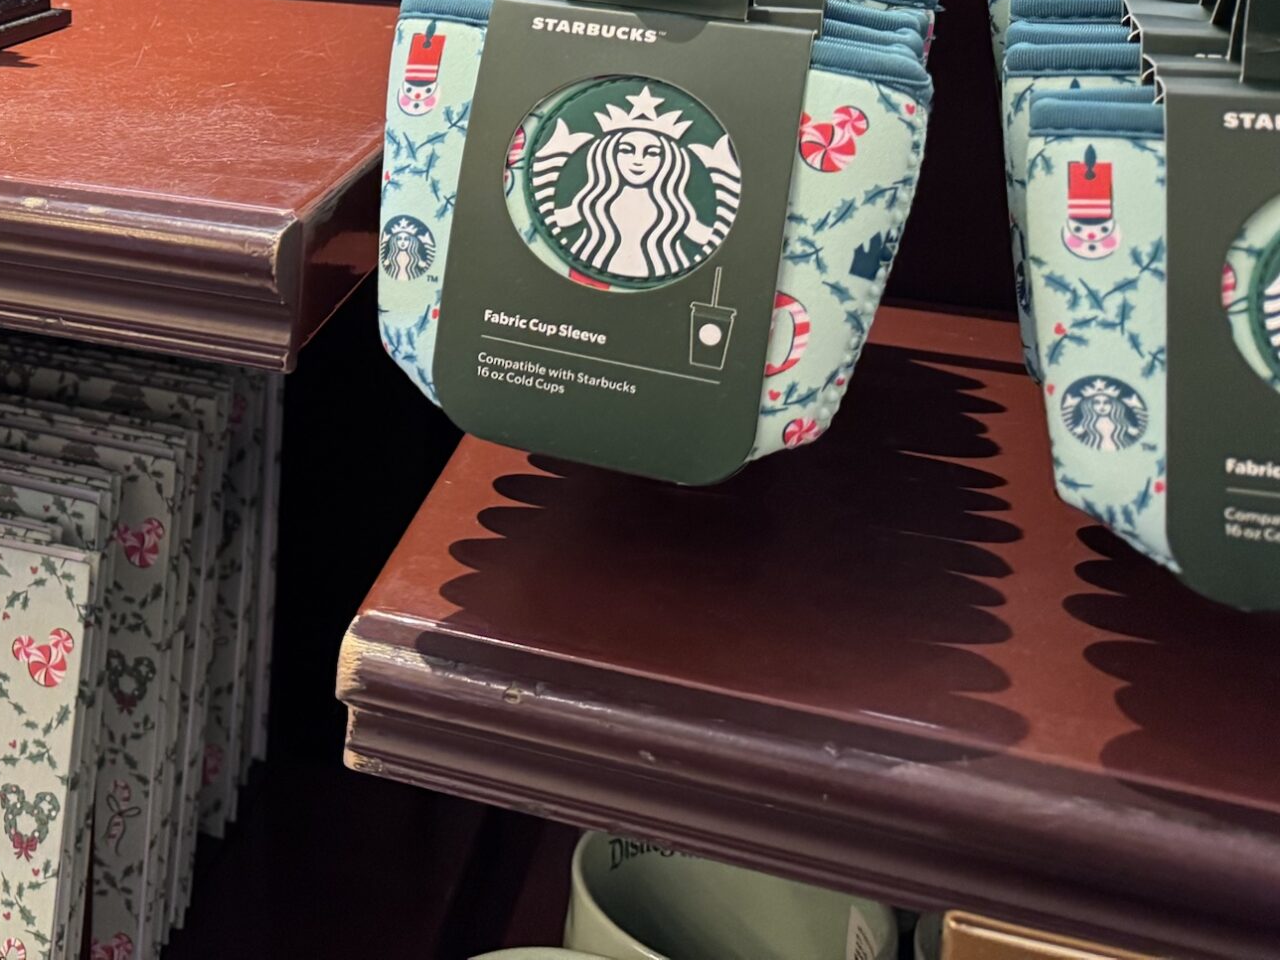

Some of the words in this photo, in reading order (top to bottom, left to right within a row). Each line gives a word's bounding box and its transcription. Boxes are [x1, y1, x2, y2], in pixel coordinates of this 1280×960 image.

[531, 17, 657, 43] STARBUCKS
[1223, 111, 1280, 131] STA
[484, 309, 527, 328] Fabric
[529, 318, 557, 336] Cup
[559, 324, 607, 345] Sleeve
[477, 366, 489, 378] 16
[491, 371, 504, 381] oz
[506, 373, 533, 387] Cold
[535, 378, 565, 394] Cups
[478, 352, 546, 375] Compatible
[549, 367, 575, 381] with
[577, 372, 637, 394] Starbucks
